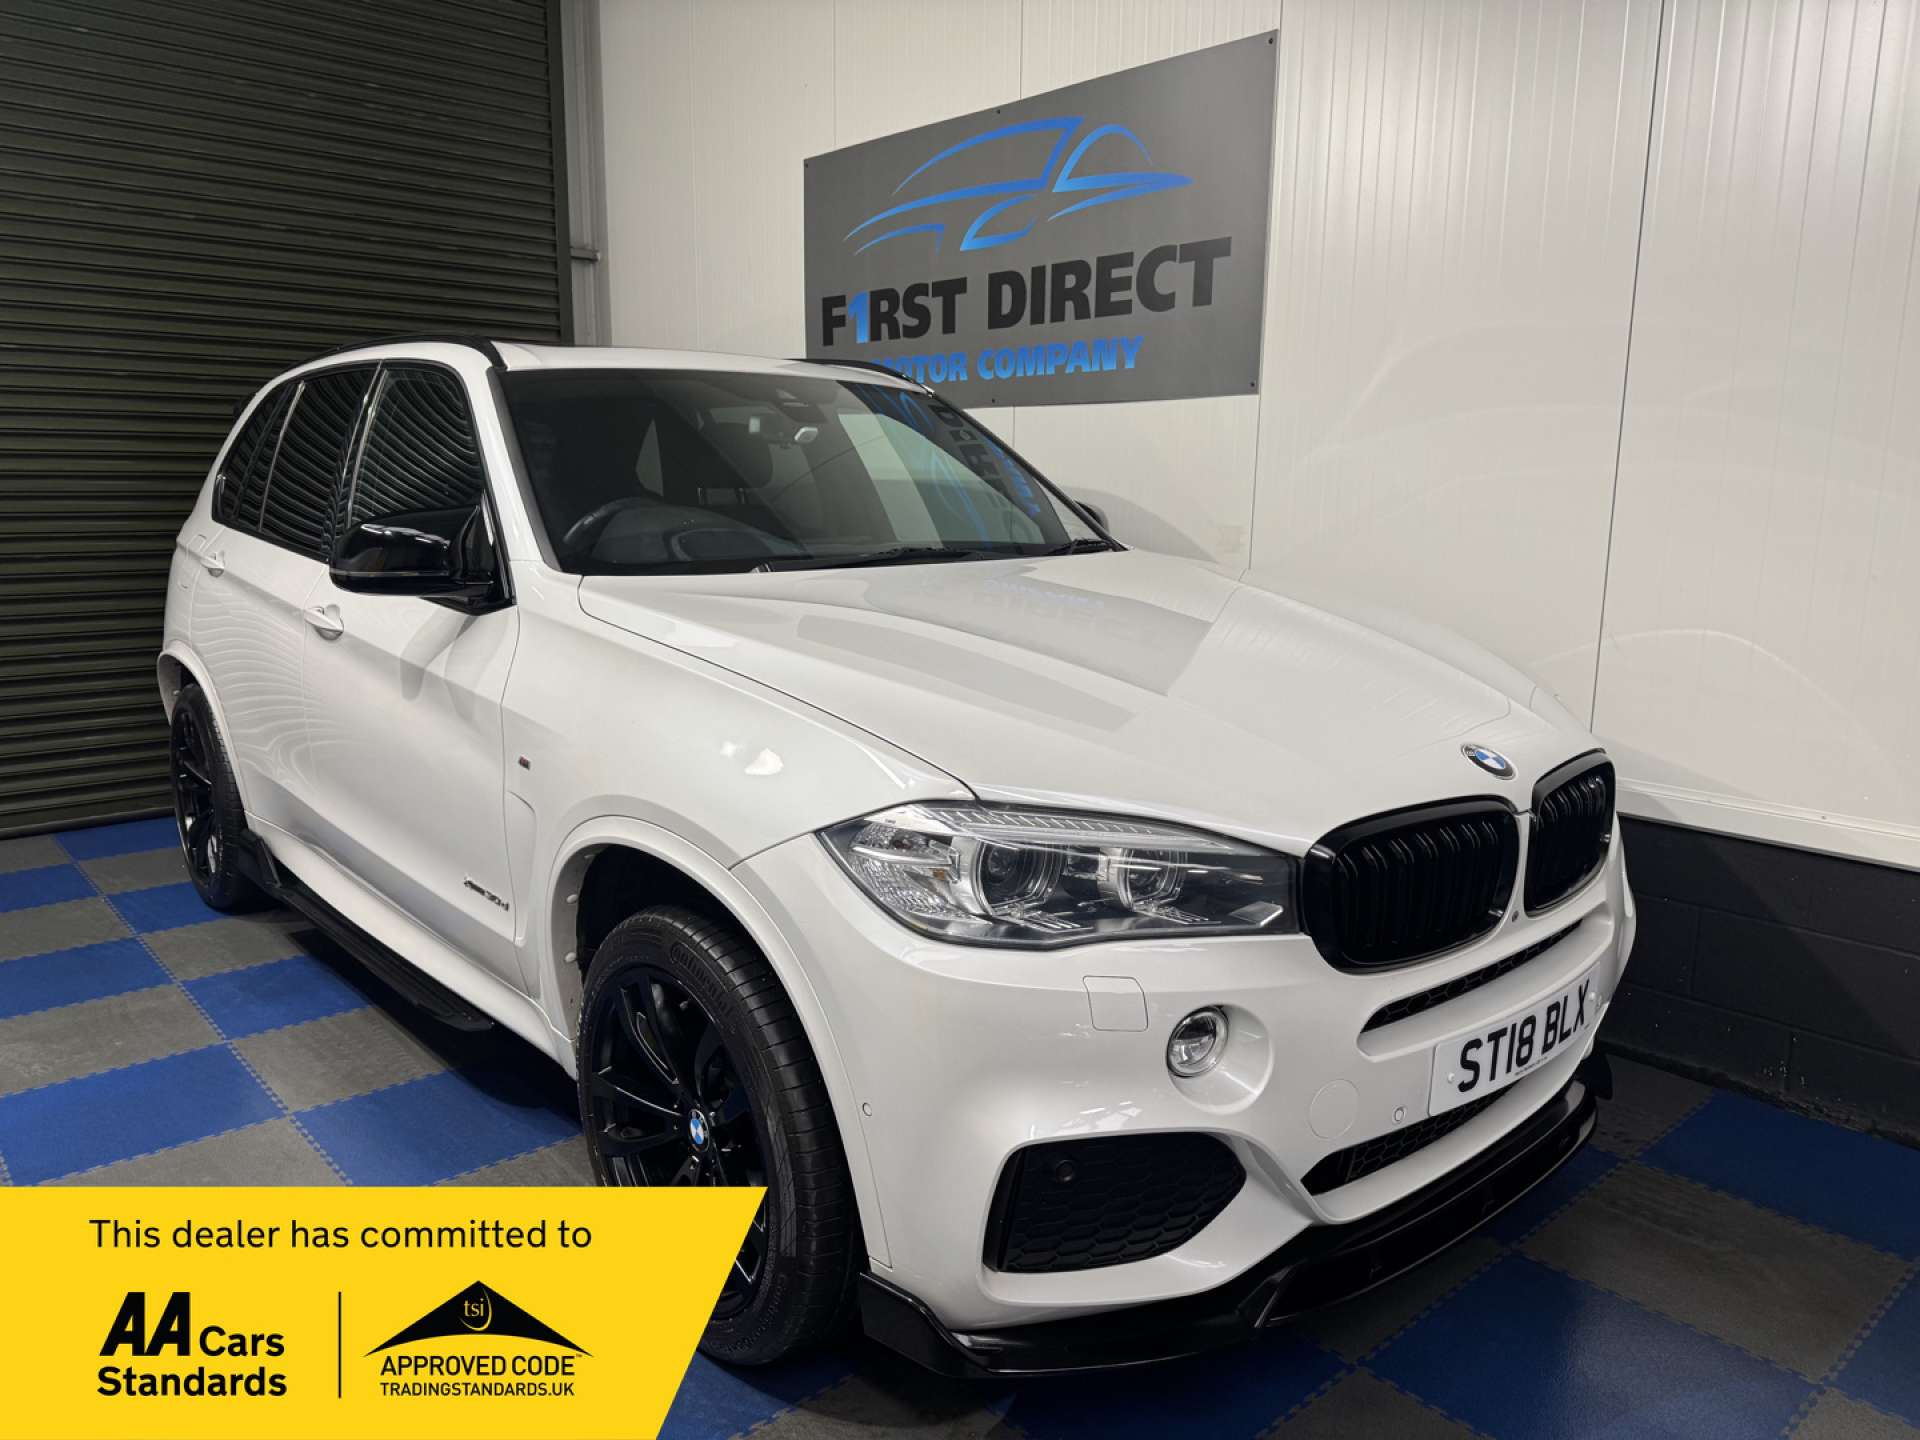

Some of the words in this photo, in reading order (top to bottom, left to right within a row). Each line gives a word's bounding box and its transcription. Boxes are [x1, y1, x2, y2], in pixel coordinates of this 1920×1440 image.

[822, 277, 967, 346] F1RST
[987, 236, 1231, 329] DIRECT
[977, 336, 1143, 379] COMPANY
[1458, 1014, 1537, 1093] ST18
[1541, 978, 1590, 1055] BLX
